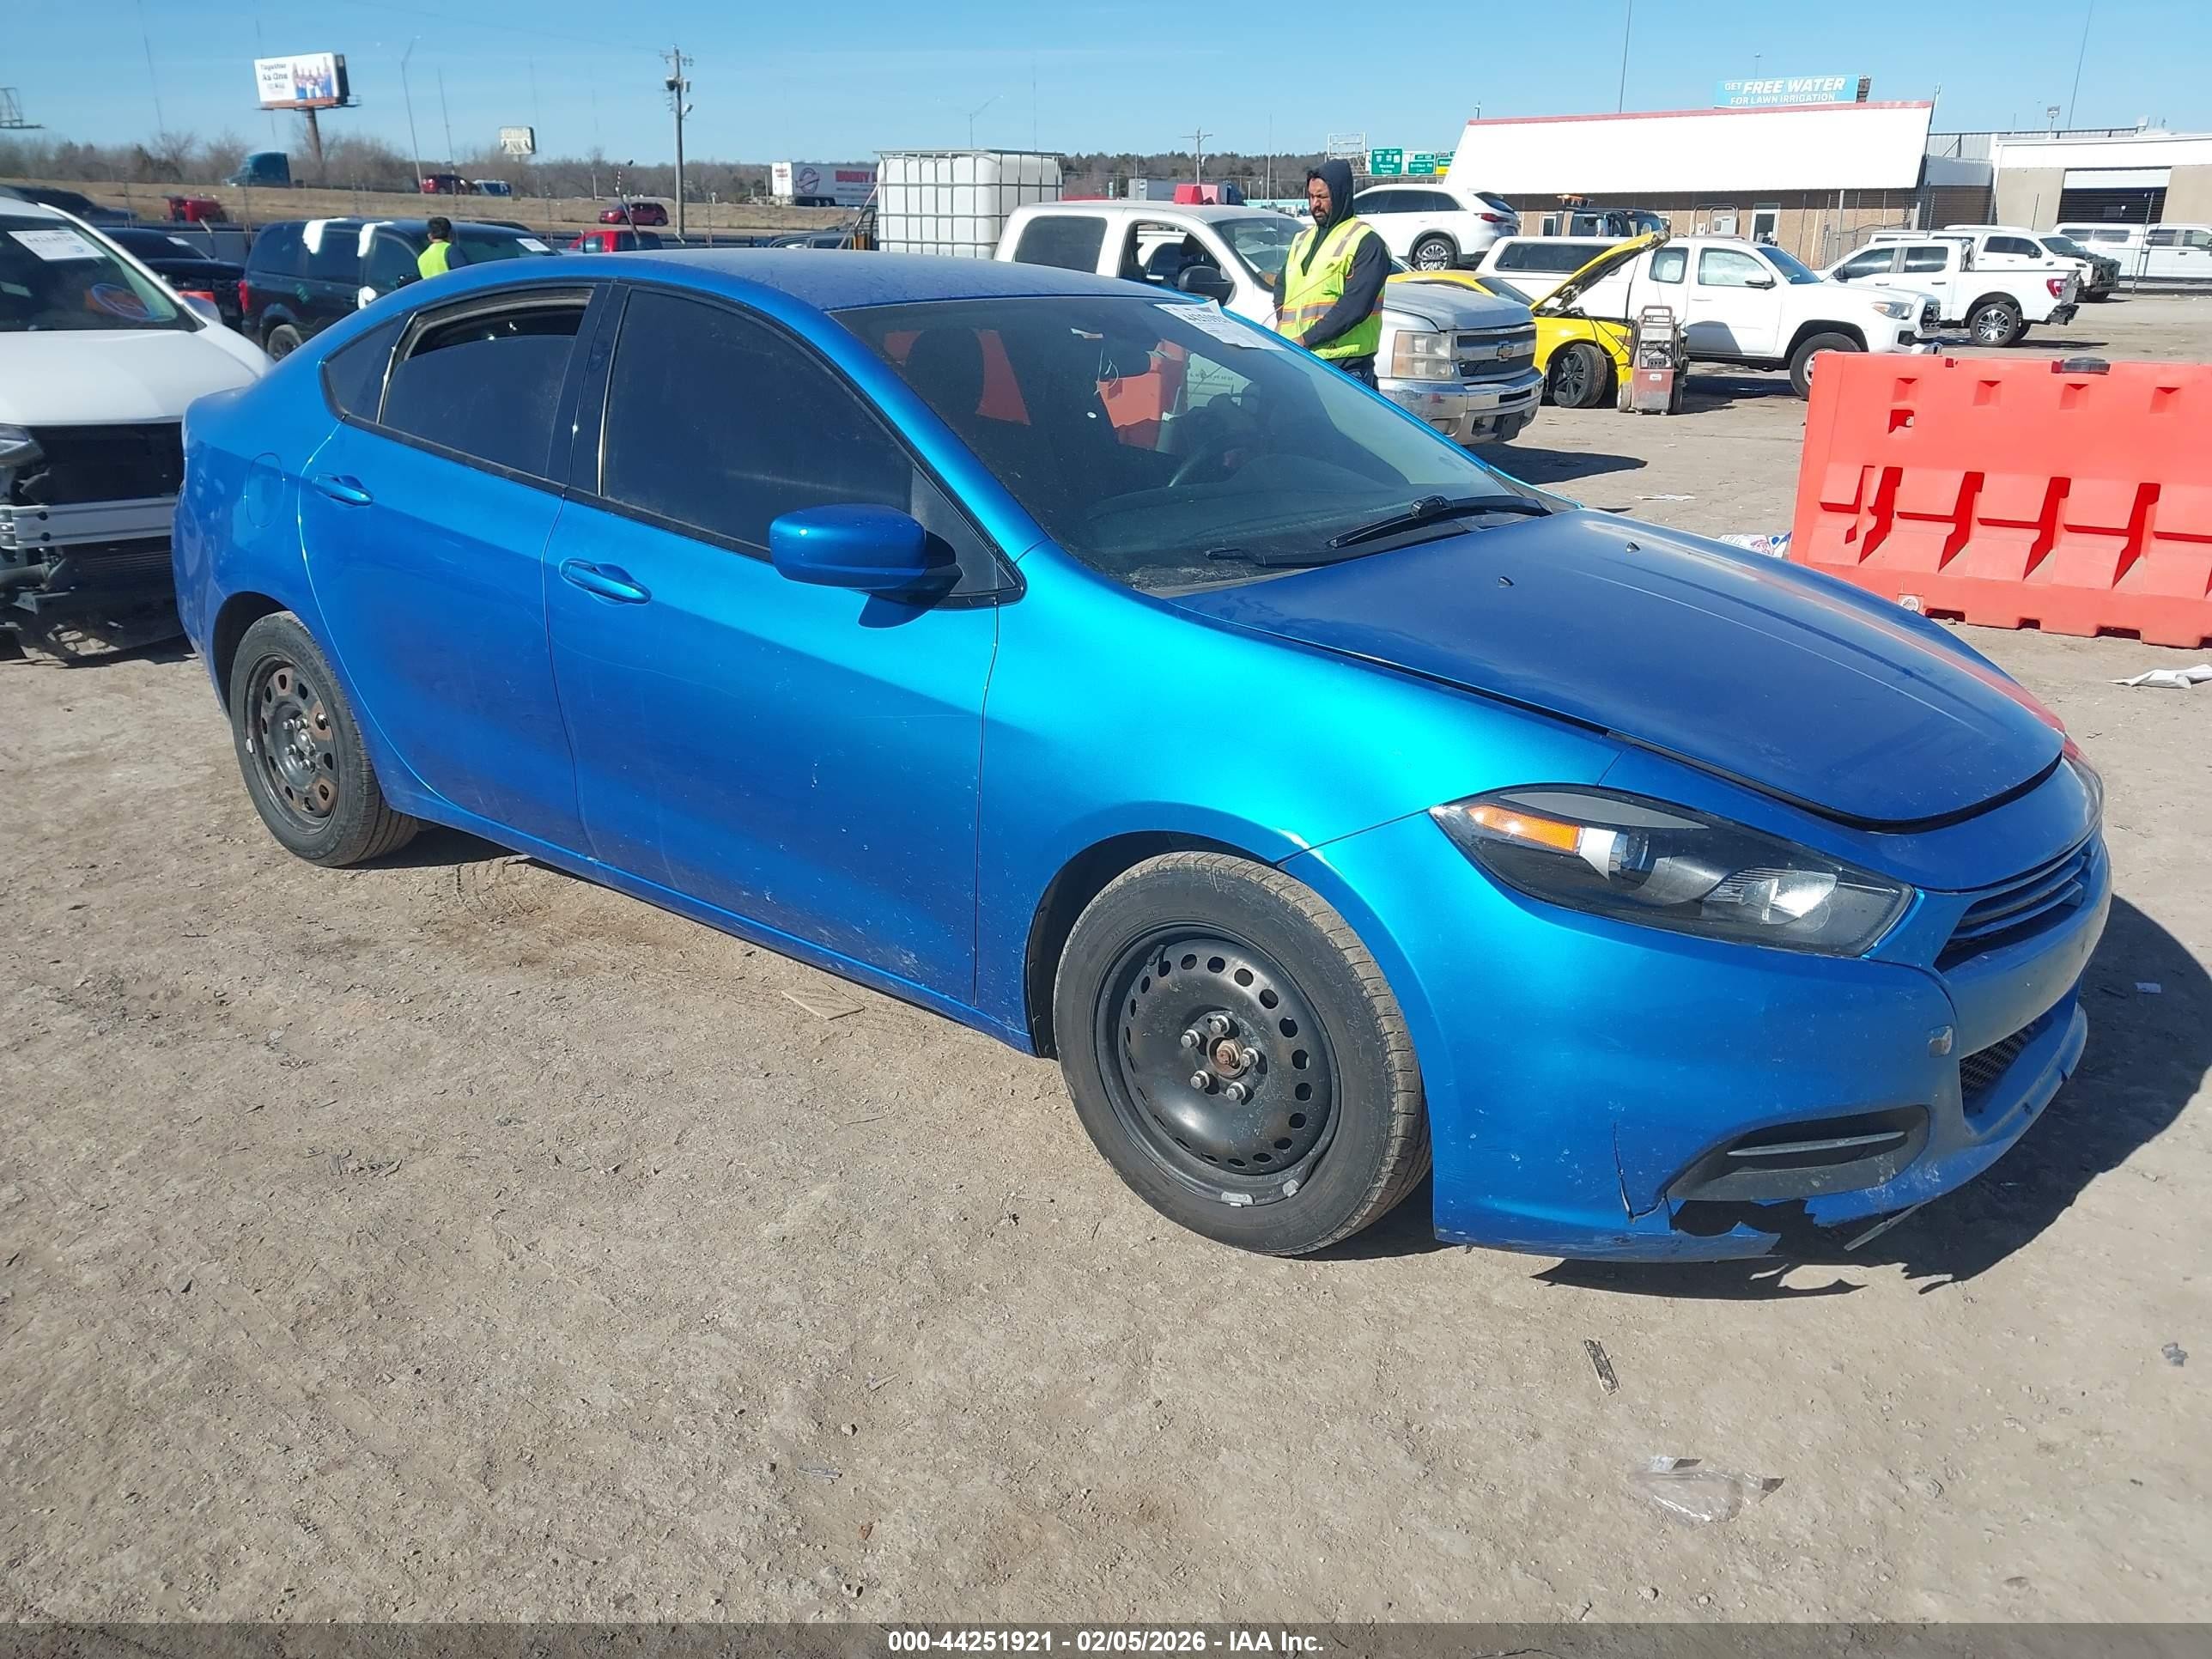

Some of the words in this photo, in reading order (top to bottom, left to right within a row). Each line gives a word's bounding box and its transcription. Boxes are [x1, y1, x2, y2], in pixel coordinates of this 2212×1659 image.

[1724, 82, 1741, 91] GET
[1741, 80, 1784, 94] FREE
[1787, 77, 1846, 93] WATER
[1730, 96, 1749, 105] FOR
[1750, 94, 1778, 105] LAWN
[1780, 93, 1836, 104] IRRIGATION
